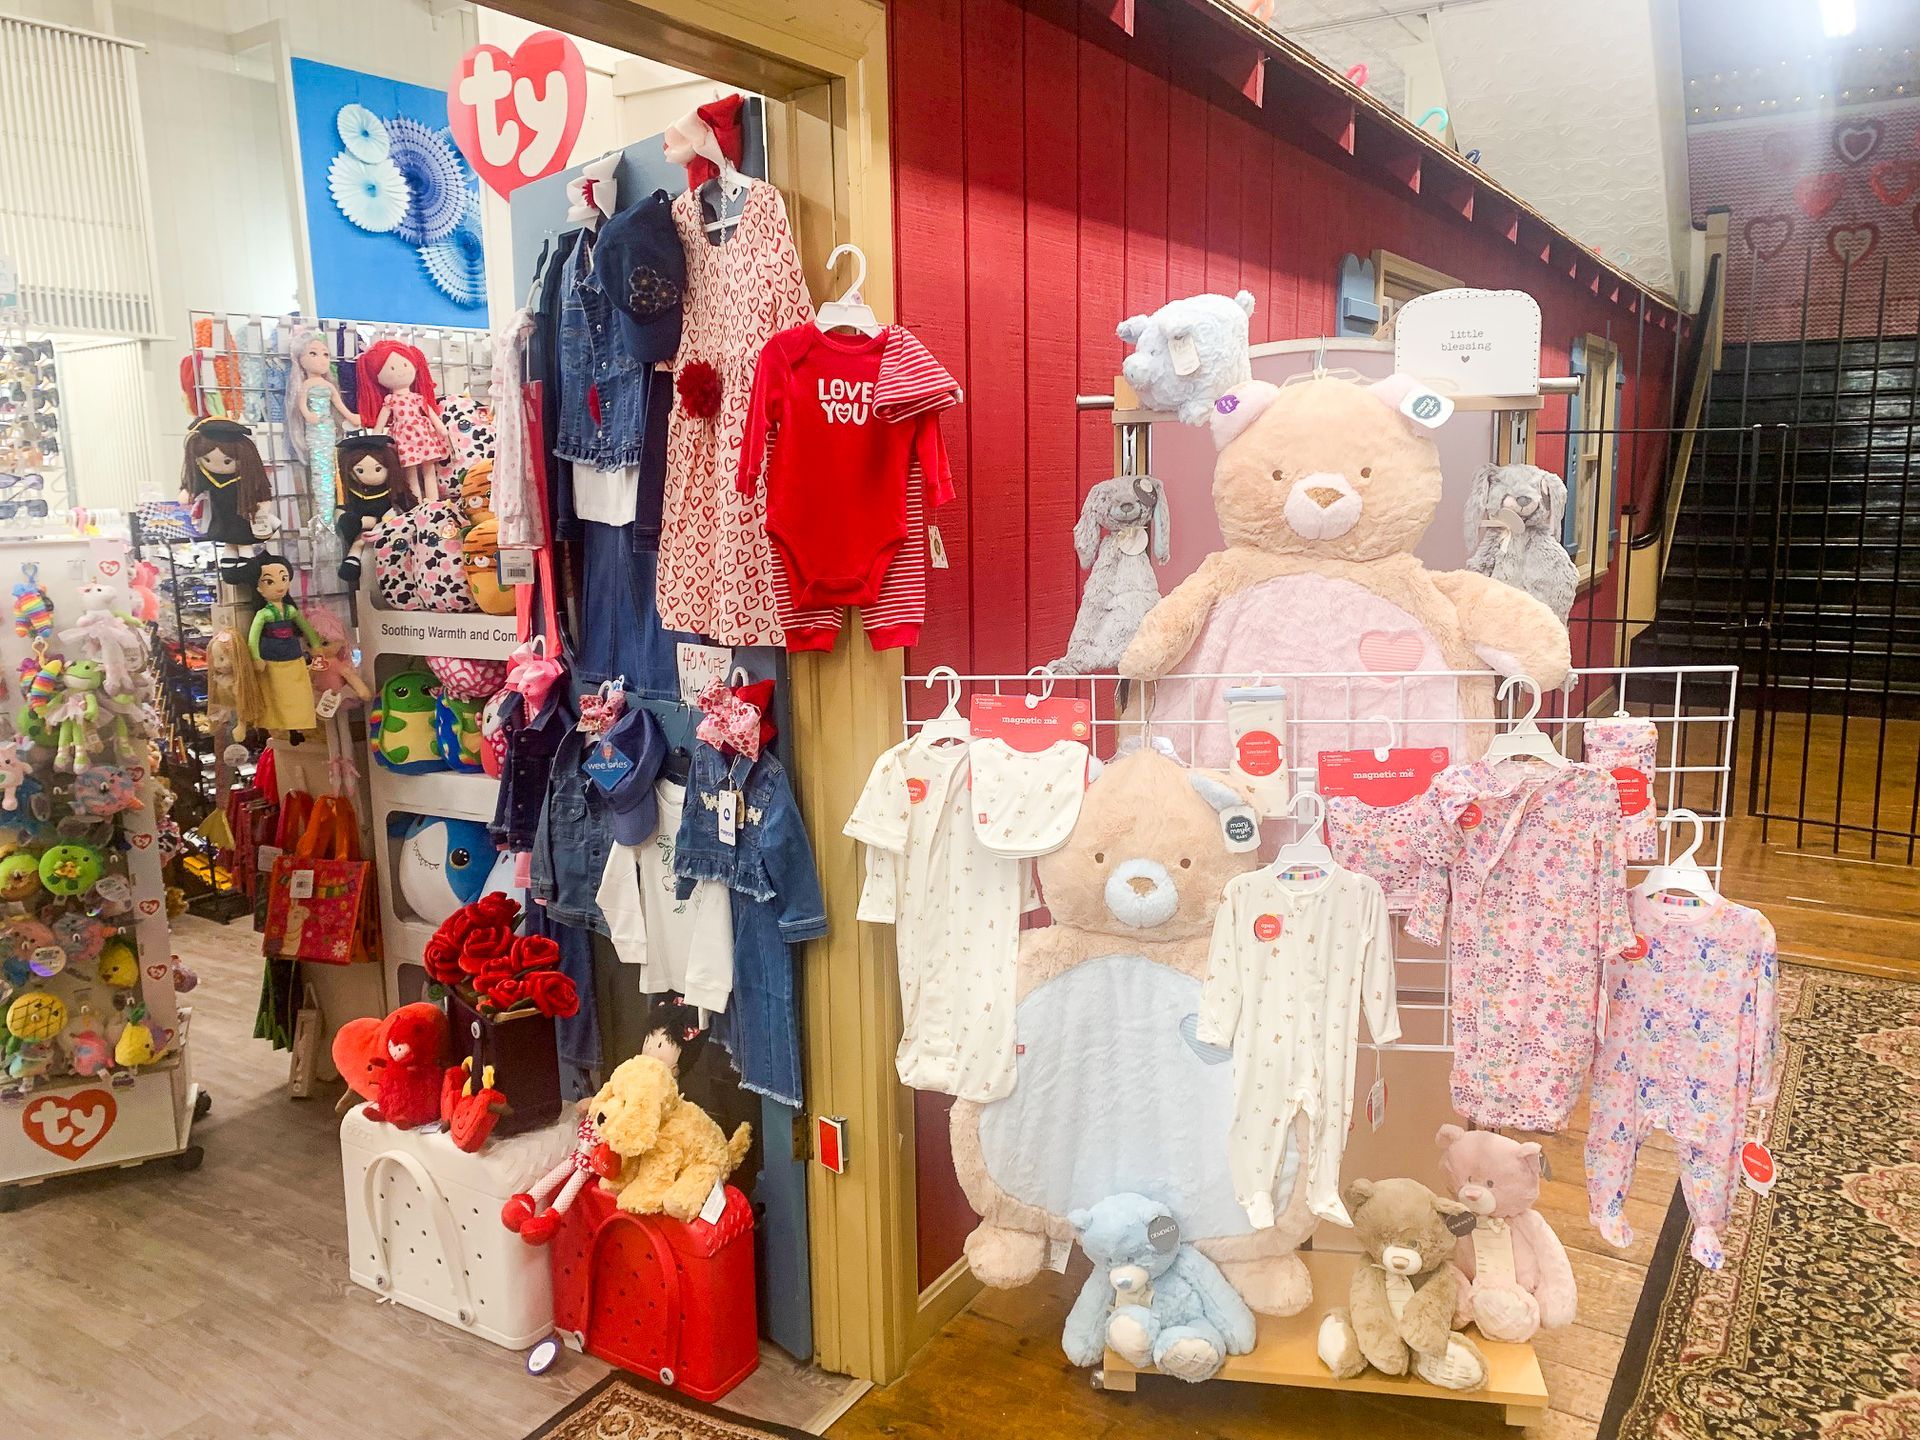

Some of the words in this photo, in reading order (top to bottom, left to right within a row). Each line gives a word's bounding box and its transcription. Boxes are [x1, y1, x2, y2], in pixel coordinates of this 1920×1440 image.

[459, 50, 569, 178] ty
[1450, 329, 1484, 339] little
[1441, 342, 1492, 352] blessing
[817, 378, 874, 403] LOVE
[381, 624, 425, 640] Soothing
[428, 626, 467, 640] Warmth
[470, 630, 489, 641] and
[1002, 715, 1042, 725] magnetic
[1353, 770, 1397, 780] magnetic
[1230, 821, 1249, 830] mary
[30, 1100, 106, 1147] ty
